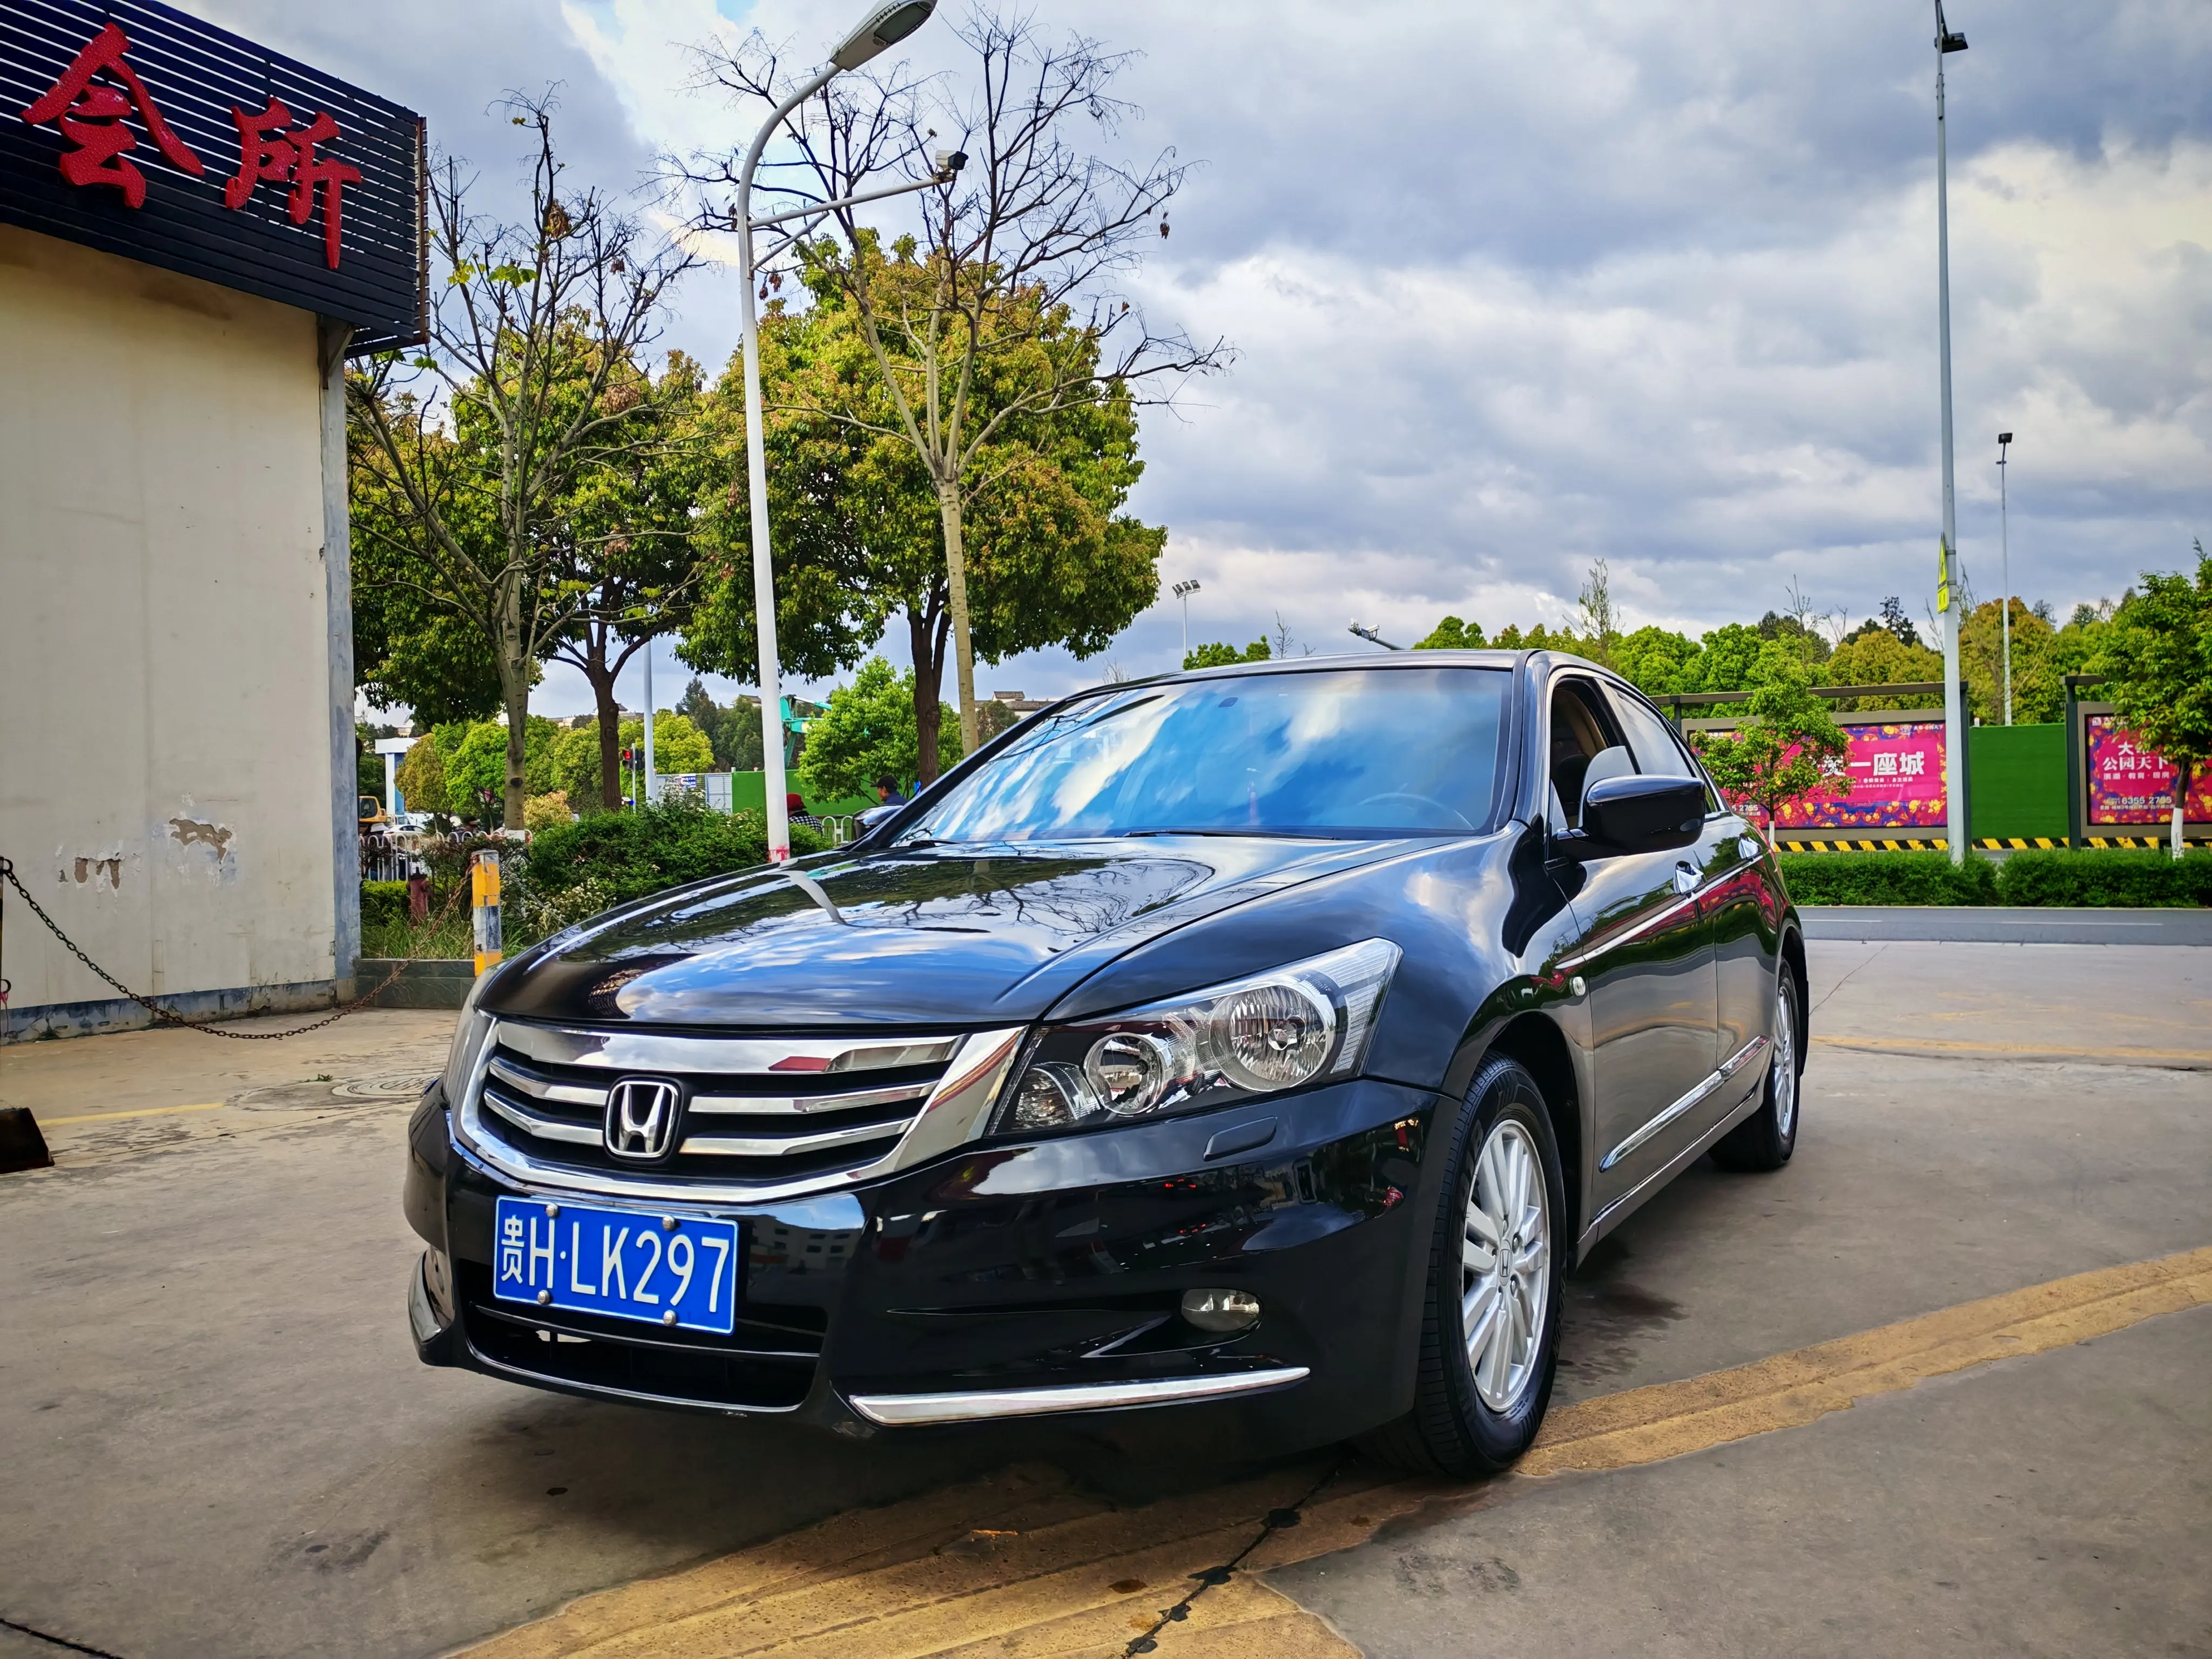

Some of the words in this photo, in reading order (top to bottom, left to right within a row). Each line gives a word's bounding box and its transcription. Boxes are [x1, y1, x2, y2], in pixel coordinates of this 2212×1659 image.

[20, 22, 362, 269] 会所
[2102, 756, 2168, 771] 公园天下
[501, 1214, 730, 1313] 贵H·LK297
